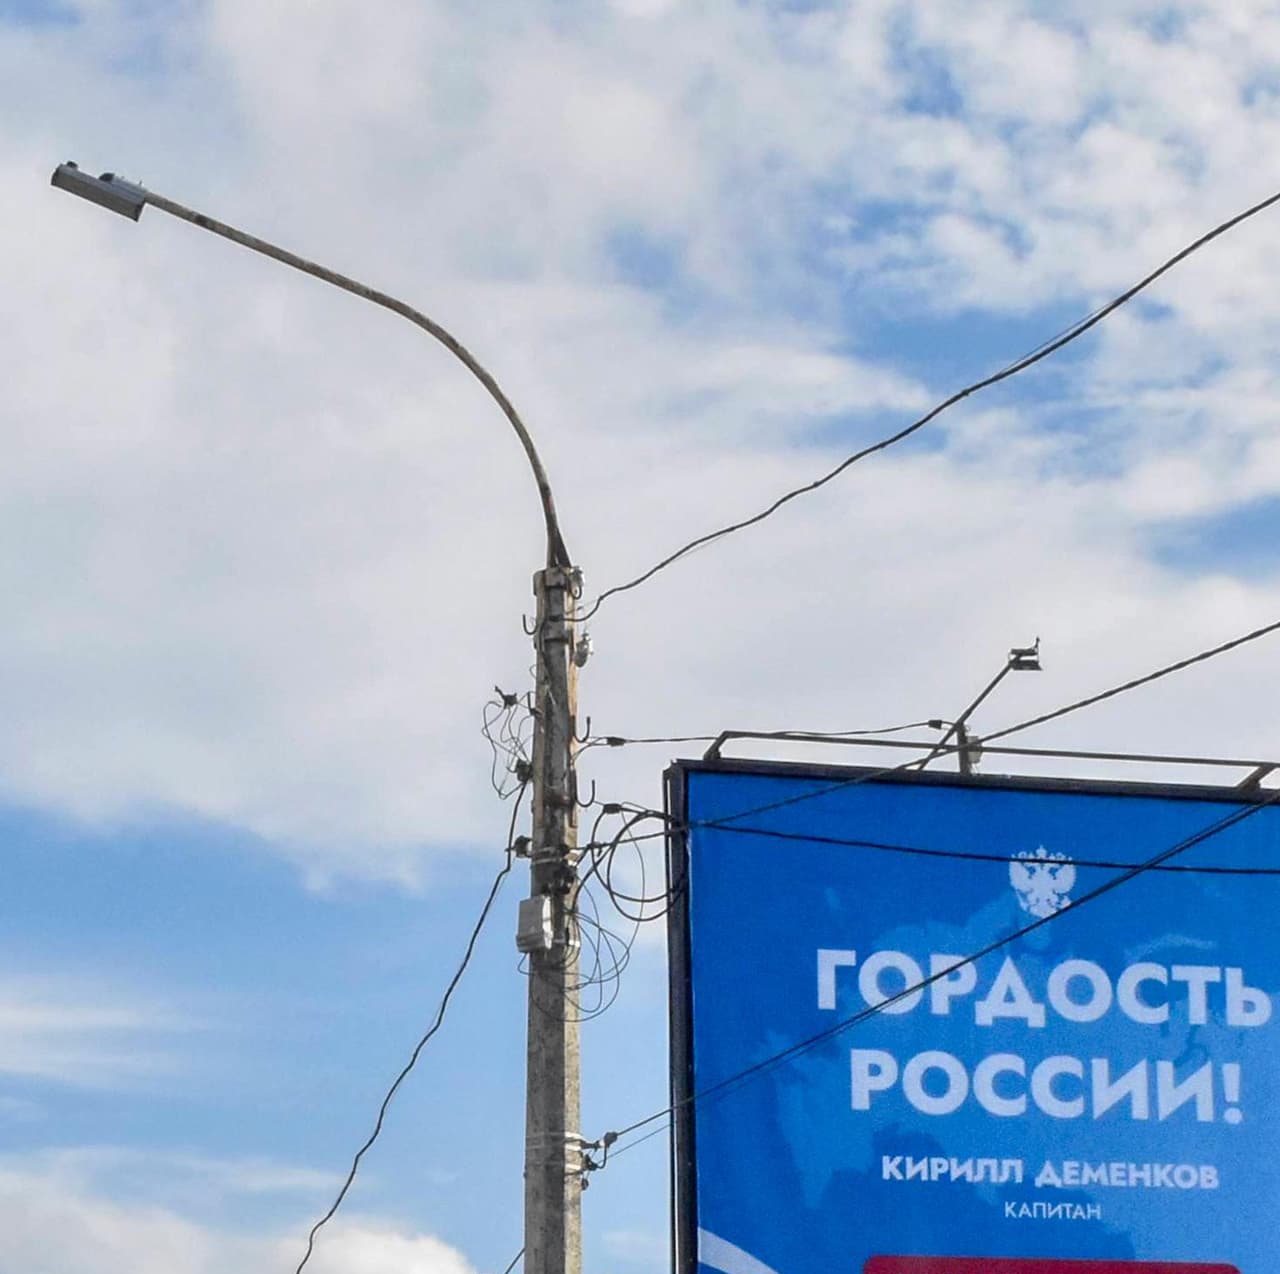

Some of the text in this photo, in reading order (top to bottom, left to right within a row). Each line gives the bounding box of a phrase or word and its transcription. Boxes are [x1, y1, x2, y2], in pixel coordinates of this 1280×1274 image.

[816, 948, 1273, 1028] ГОРДОСТЬ
[849, 1048, 1245, 1125] РОССИИ!
[881, 1154, 1219, 1190] КИРИЛЛ ДЕМЕНКОВ
[1003, 1201, 1102, 1221] КАПИТАН
